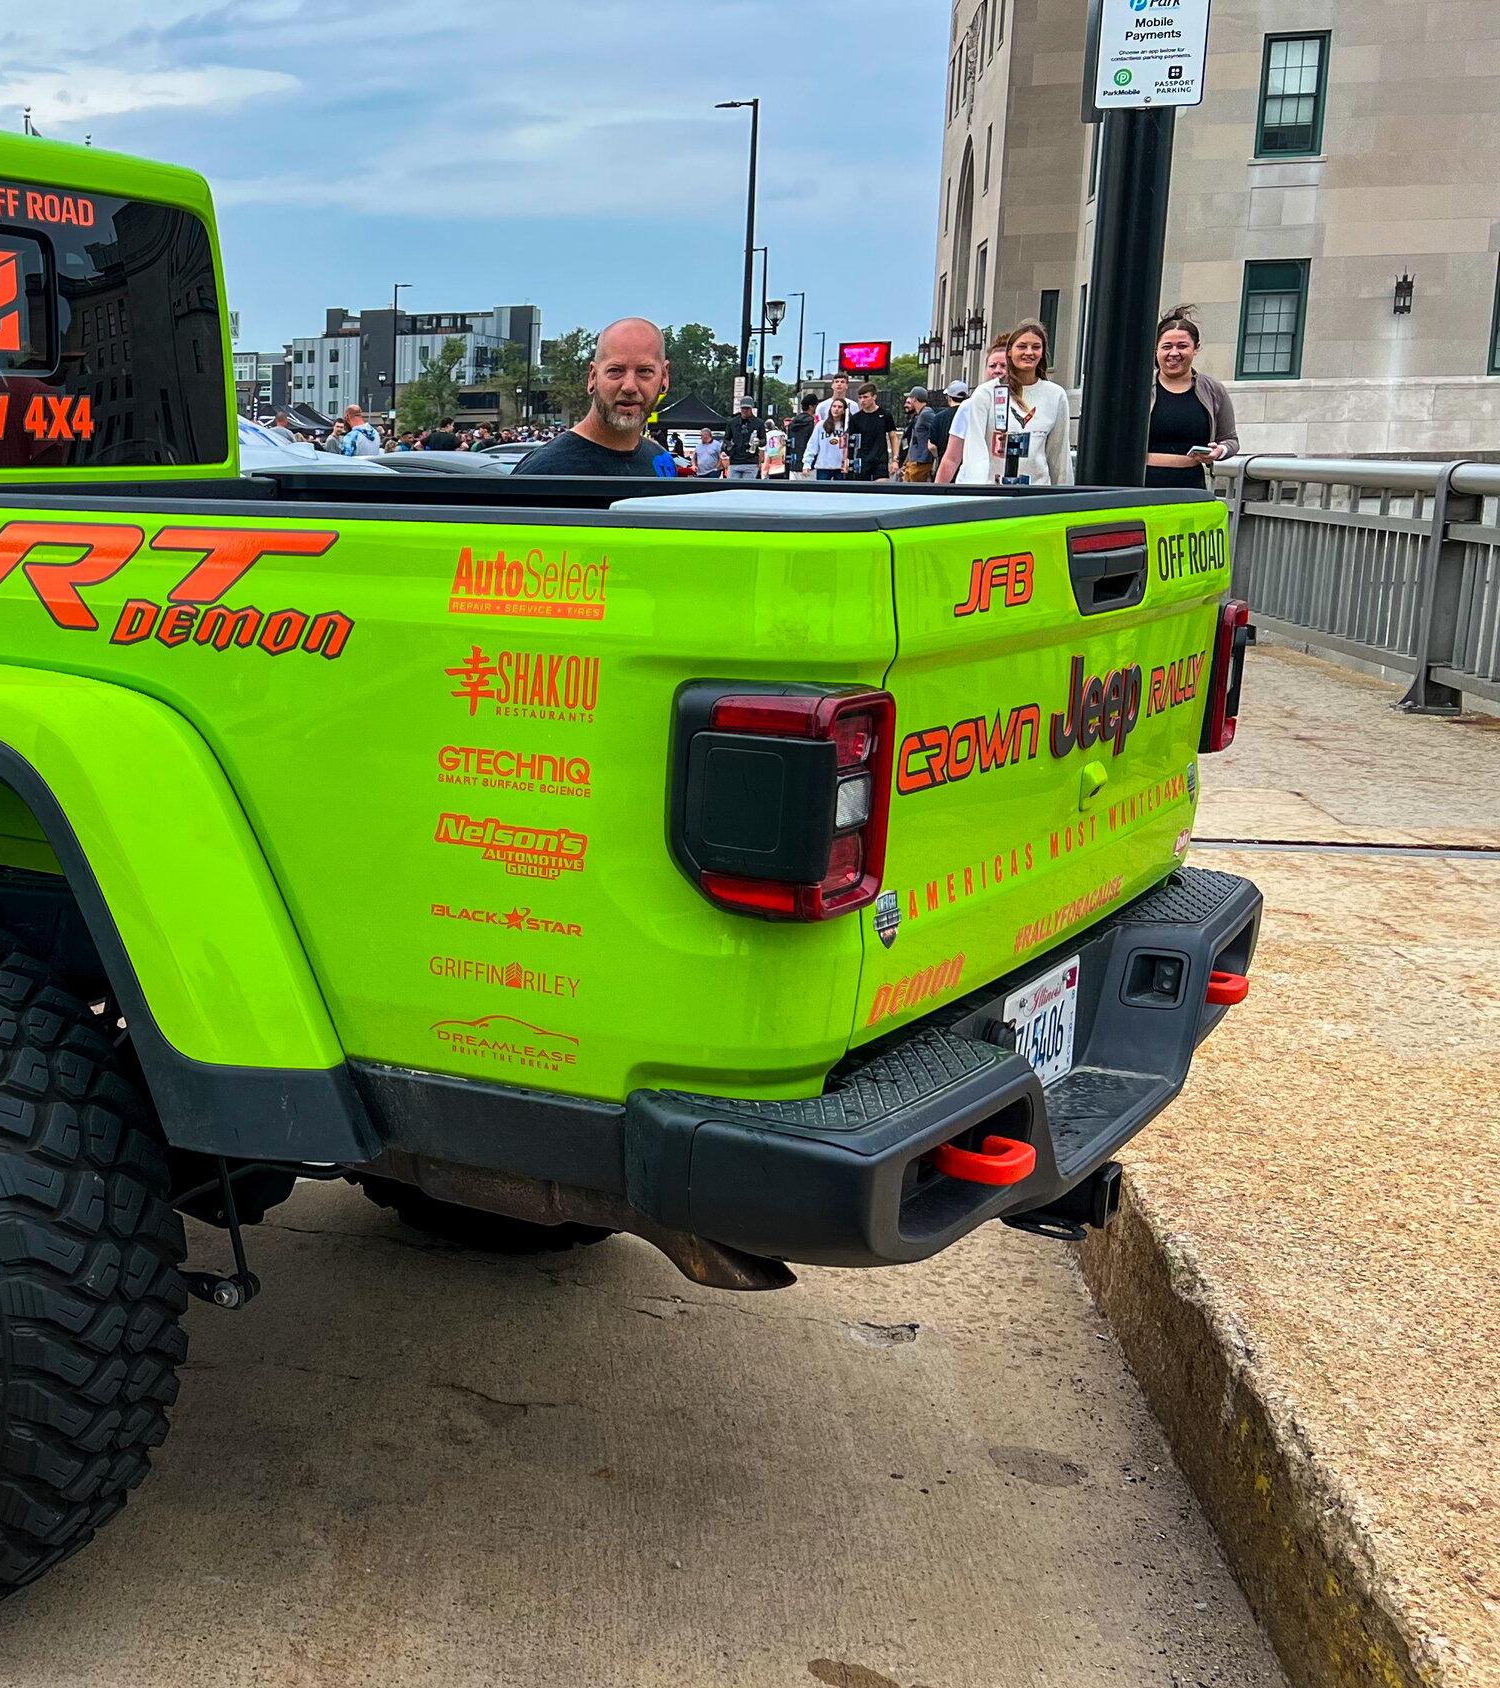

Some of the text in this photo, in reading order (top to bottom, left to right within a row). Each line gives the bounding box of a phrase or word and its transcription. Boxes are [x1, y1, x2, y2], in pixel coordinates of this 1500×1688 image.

[1125, 30, 1182, 42] Payments
[1135, 17, 1174, 28] Mobile
[25, 191, 95, 227] ROAD
[24, 393, 96, 440] 4X4
[1157, 528, 1225, 582] OFF ROAD
[954, 551, 1034, 617] JFB
[452, 601, 600, 617] REPAIR SERVICE TIRES
[109, 599, 356, 660] DEMON
[496, 651, 600, 711] SHAKOU
[495, 706, 594, 724] RESTAURANTS
[897, 651, 1206, 796] CROWN Jeep RALLY
[438, 745, 591, 785] GTECHNIQ
[437, 773, 591, 798] SMART SURFACE SCIENCE
[439, 815, 586, 856] Nelson's
[484, 849, 584, 871] AUTOMOTIVE
[506, 863, 560, 879] GROUP
[908, 842, 1033, 920] AMERICAS
[1049, 815, 1097, 859] MOST
[1108, 788, 1161, 832] WANTED
[430, 904, 582, 936] BLACK STAR
[429, 956, 581, 998] GRIFFIN RILEY
[866, 952, 967, 1027] DEMON
[1023, 983, 1061, 1017] Illinois
[437, 1030, 577, 1065] DREAMLEASE
[452, 1045, 560, 1072] DRIVE THE DREAM
